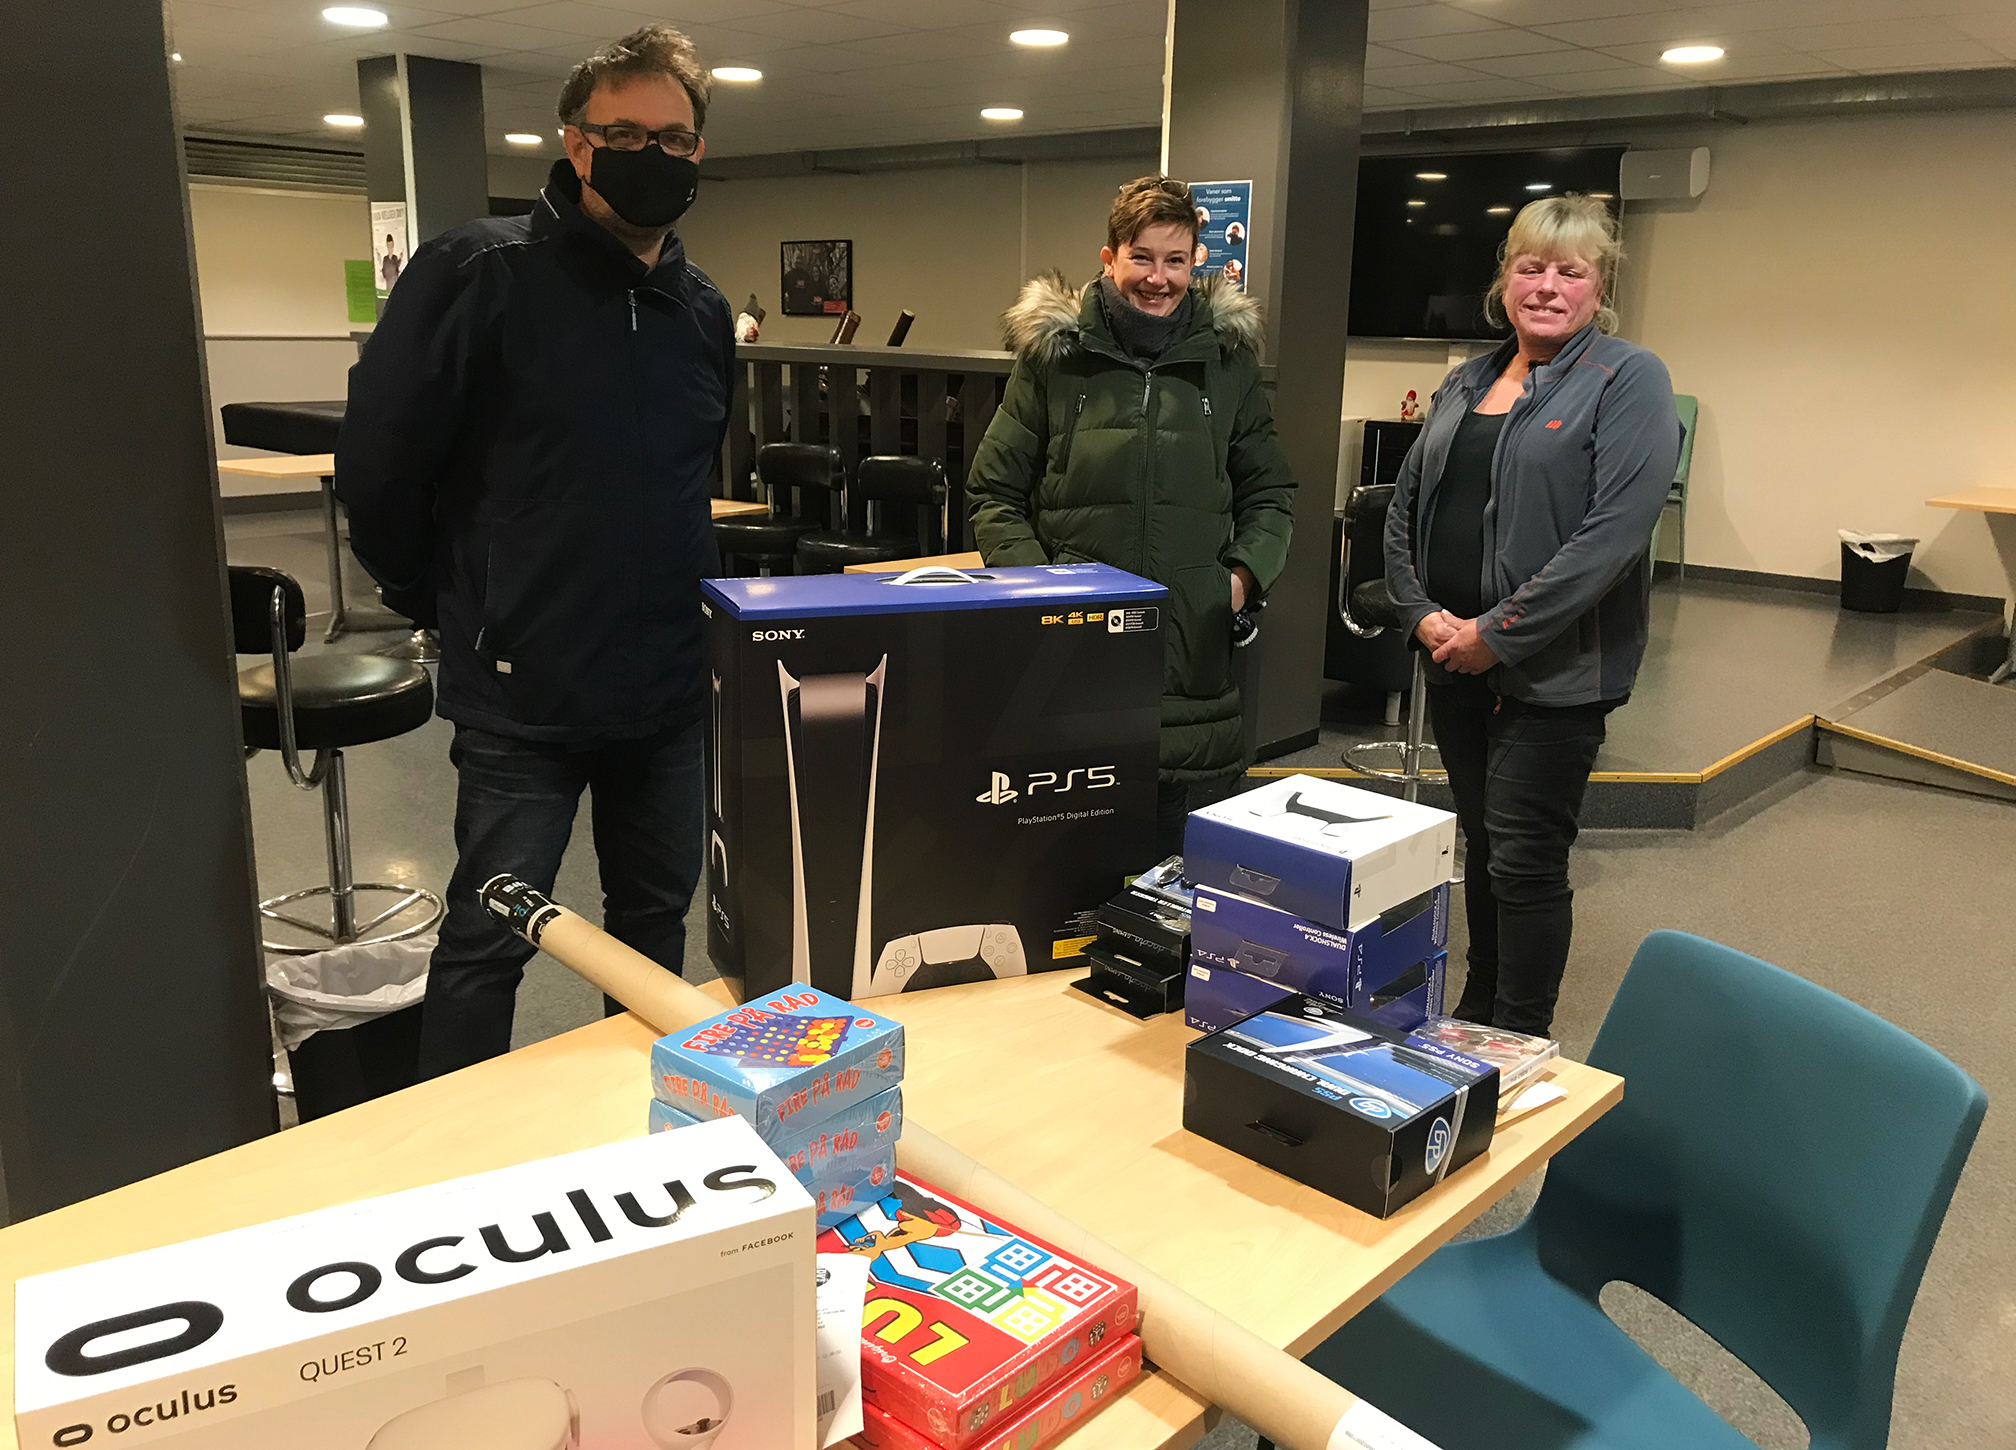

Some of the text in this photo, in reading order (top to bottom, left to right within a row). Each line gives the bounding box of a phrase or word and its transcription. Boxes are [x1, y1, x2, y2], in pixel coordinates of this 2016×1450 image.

[752, 629, 805, 641] SONY
[1041, 615, 1064, 625] 8K
[1088, 613, 1103, 621] HDR
[1027, 765, 1116, 796] PS5
[1066, 810, 1089, 820] Digital
[1090, 808, 1114, 817] Edition
[1293, 923, 1347, 944] Wireless Controller
[1197, 949, 1225, 964] PS4
[1318, 991, 1344, 1004] SONY
[681, 992, 820, 1053] FIRE PÅ RAD
[1189, 1016, 1217, 1031] PS4
[1223, 1042, 1352, 1096] DUAL CHARGING DOCK
[1419, 1043, 1480, 1069] SONY PS5
[663, 1074, 689, 1097] FIRE
[692, 1078, 709, 1108] PÅ
[776, 1065, 860, 1123] FIRE PÅ RAD
[1312, 1086, 1343, 1101] PS5
[785, 1127, 859, 1174] RE PÅ RAD
[816, 1183, 854, 1218] Å RAD
[286, 1163, 777, 1314] oculus
[720, 1231, 794, 1259] from FACEBOOK
[862, 1284, 971, 1367] LU
[299, 1335, 408, 1385] QUEST 2
[999, 1338, 1080, 1412] LUDO
[106, 1380, 238, 1434] oculus
